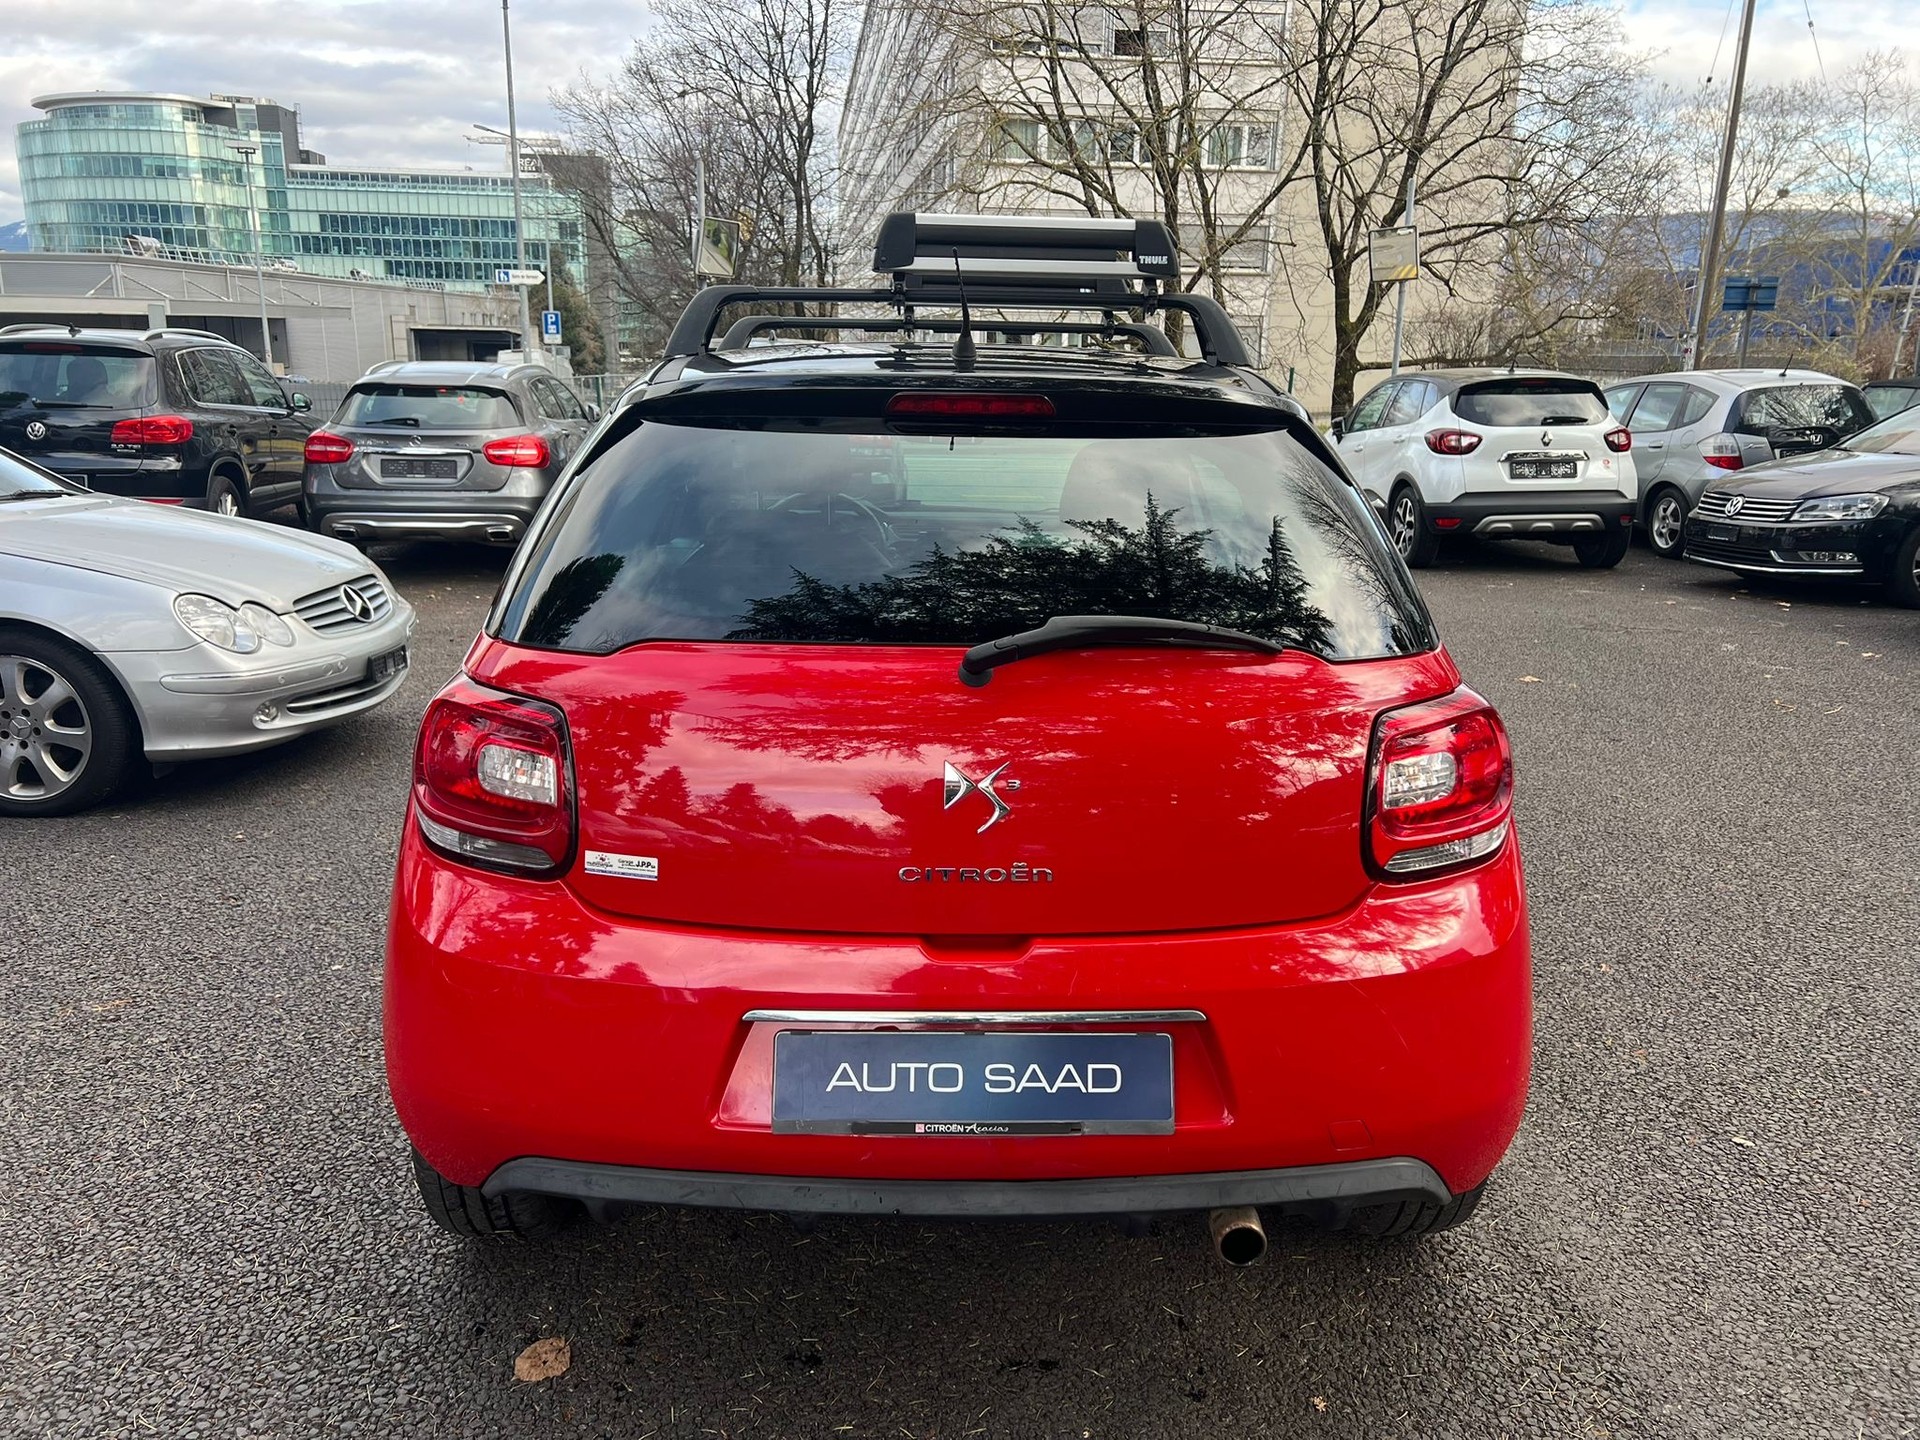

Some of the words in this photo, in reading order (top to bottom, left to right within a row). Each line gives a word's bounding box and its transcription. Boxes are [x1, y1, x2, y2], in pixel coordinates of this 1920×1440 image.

[1139, 255, 1168, 265] THULE
[547, 313, 556, 325] P
[825, 1062, 965, 1093] AUTO
[983, 1063, 1123, 1094] SAAD
[925, 1122, 964, 1133] CITROËN
[964, 1122, 1010, 1134] Acacias
